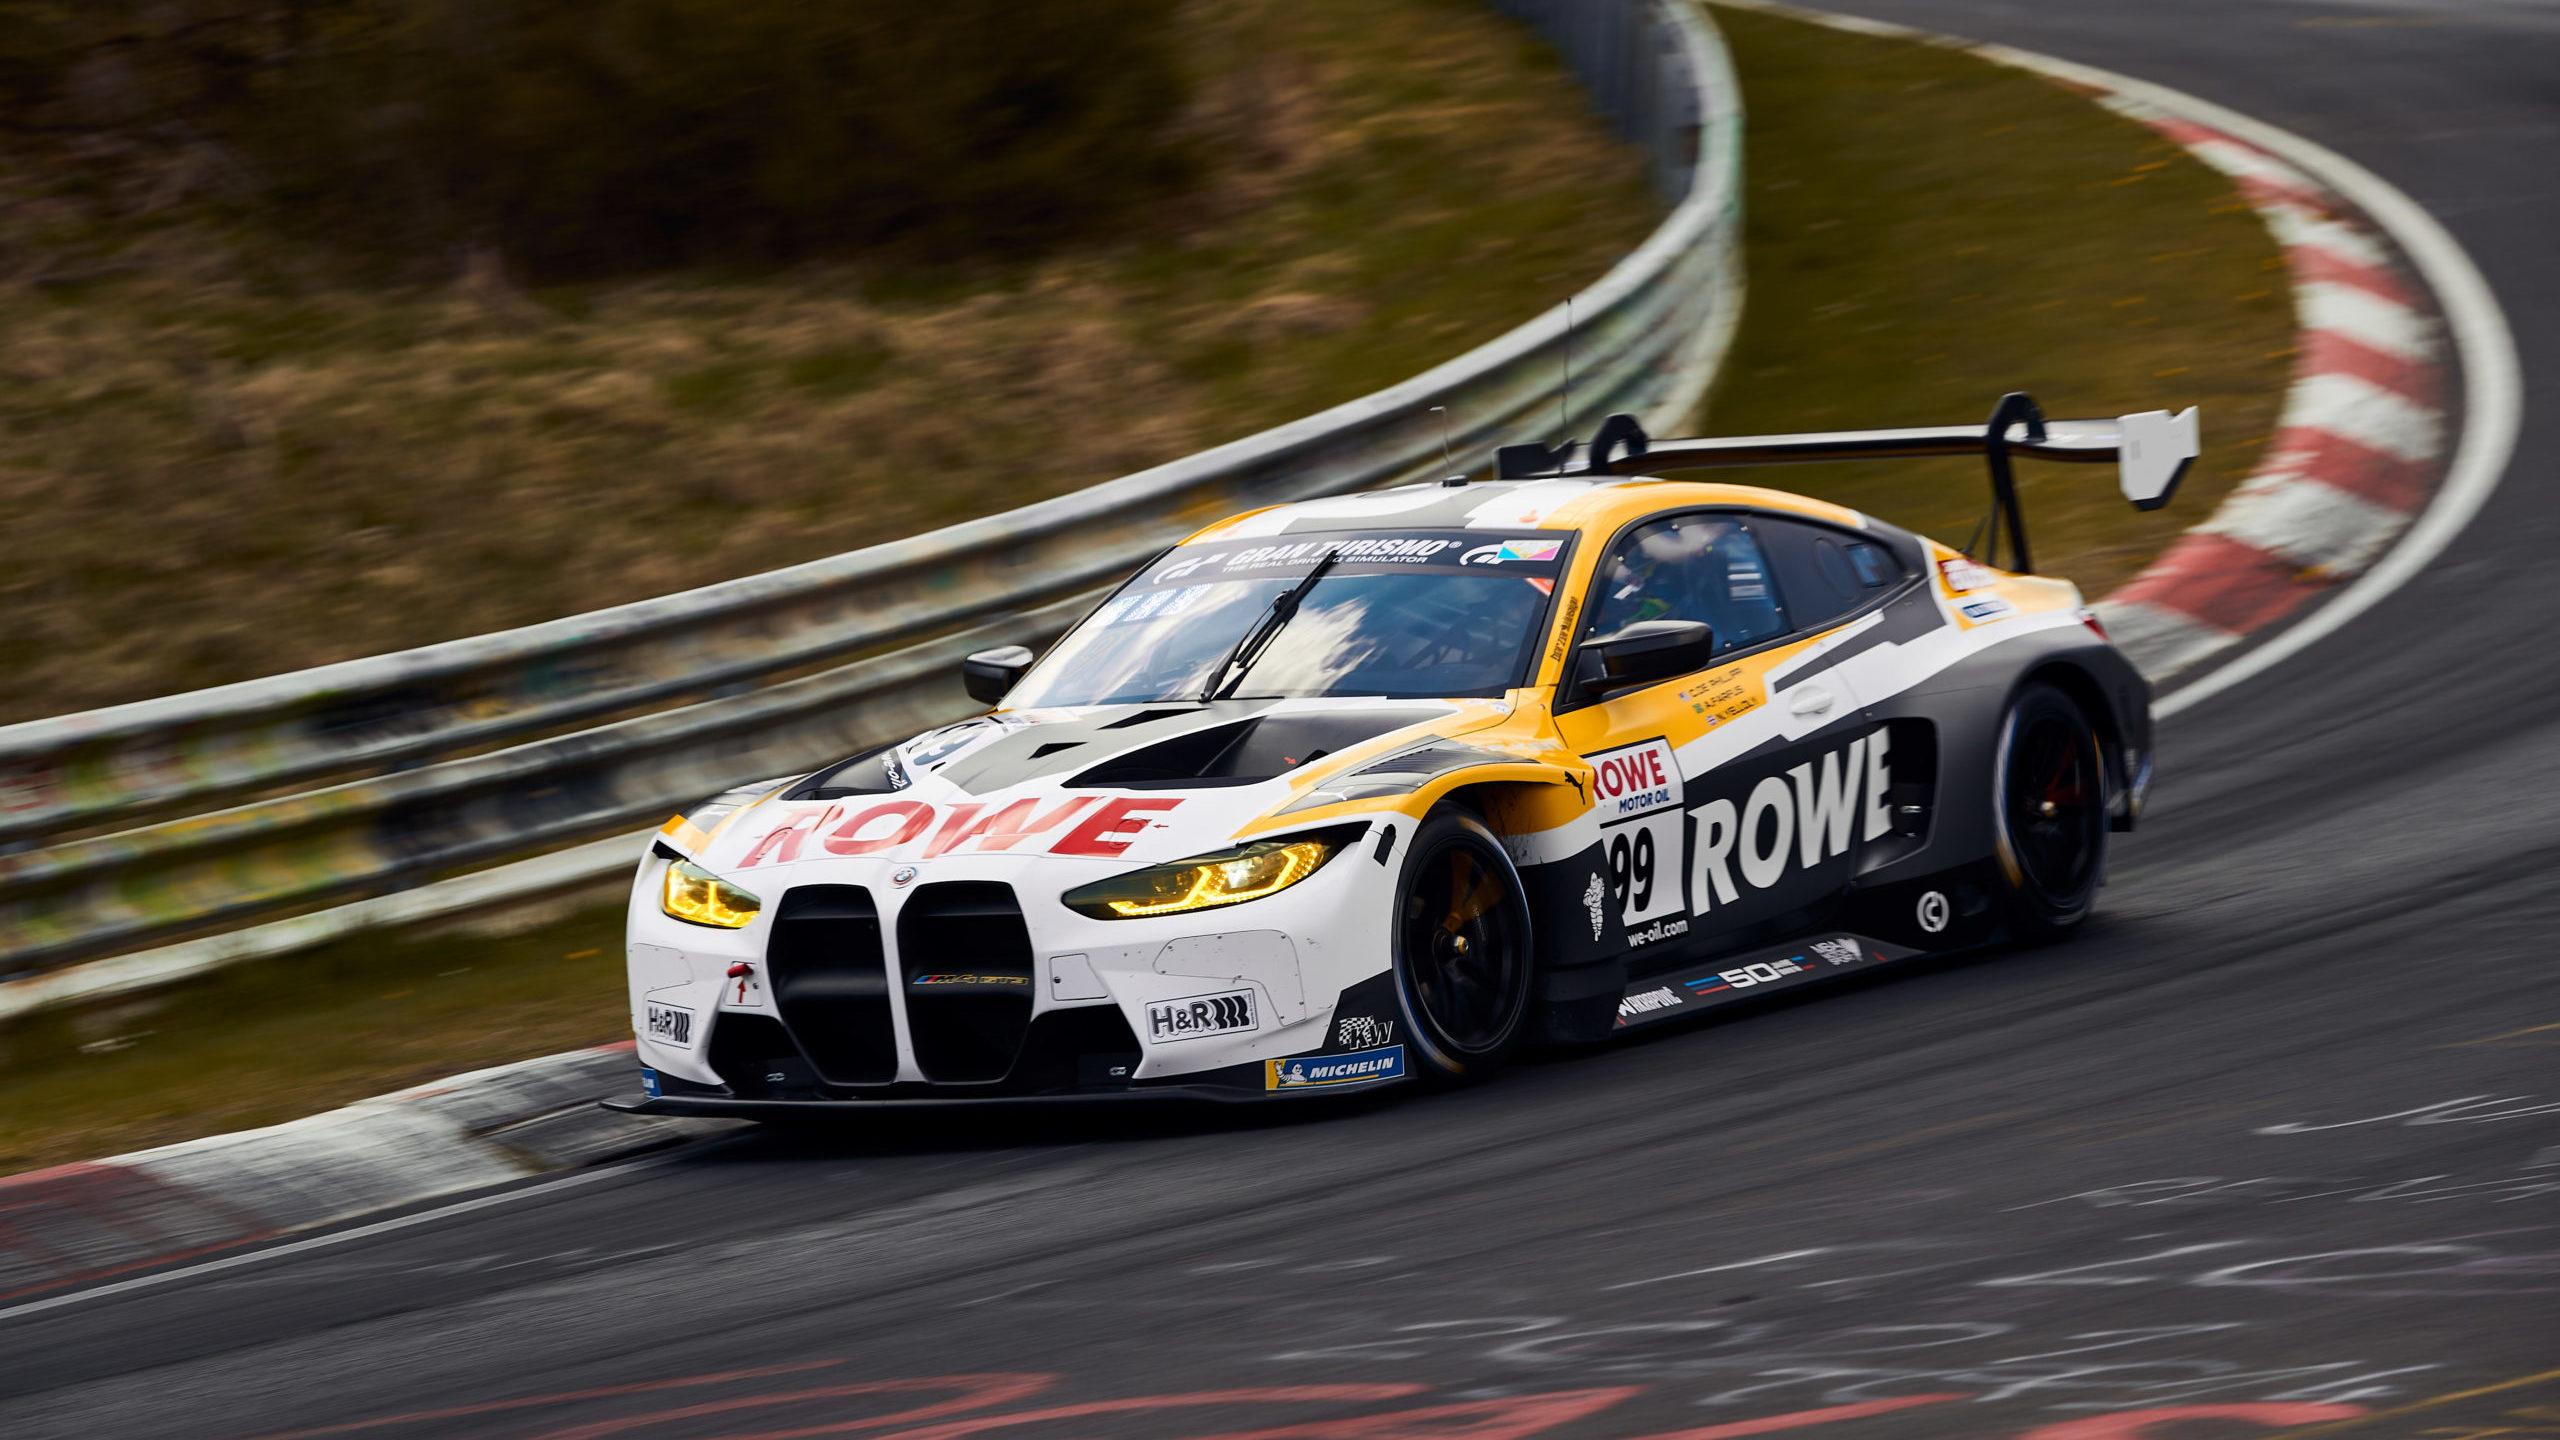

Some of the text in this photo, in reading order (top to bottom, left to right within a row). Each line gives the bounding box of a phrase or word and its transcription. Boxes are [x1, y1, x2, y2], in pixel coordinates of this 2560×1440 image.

[1222, 563, 1252, 573] THE
[1254, 559, 1284, 570] REAL
[1345, 555, 1428, 564] SIMULATOR
[1227, 542, 1318, 566] GRAN
[1593, 749, 1666, 801] ROWE
[1618, 788, 1670, 814] MOTOR OIL
[737, 797, 1186, 869] ROWE
[1687, 725, 1893, 917] ROWE
[1610, 826, 1655, 915] 99
[1627, 919, 1689, 948] we-oil.com
[1718, 962, 1782, 989] 50
[1150, 1001, 1214, 1038] H&R
[1309, 1056, 1395, 1079] MICHELIN
